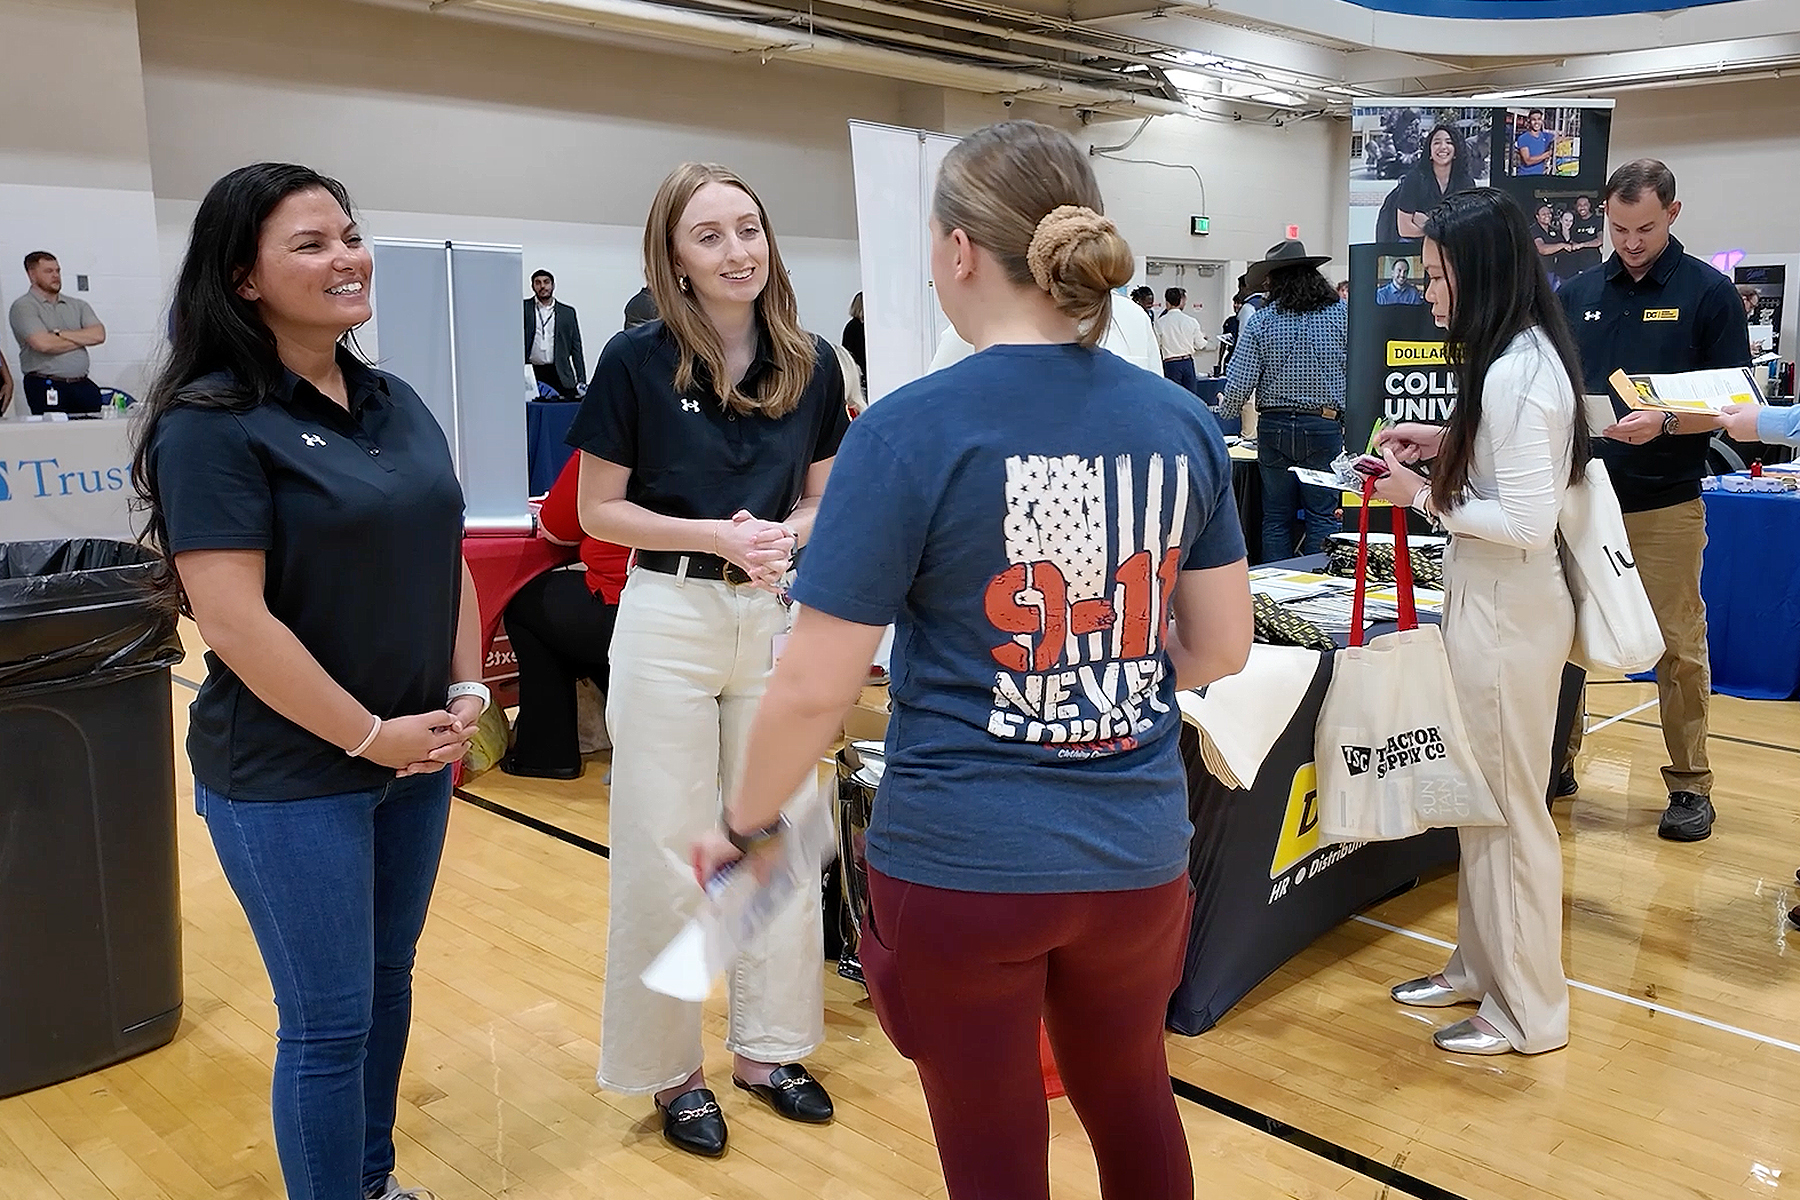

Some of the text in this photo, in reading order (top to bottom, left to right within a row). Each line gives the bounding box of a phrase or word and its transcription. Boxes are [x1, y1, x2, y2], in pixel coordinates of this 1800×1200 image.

[1384, 398, 1458, 420] UNIV
[1376, 727, 1442, 762] TACTOR
[1344, 747, 1368, 771] TSC
[1268, 876, 1291, 905] HR
